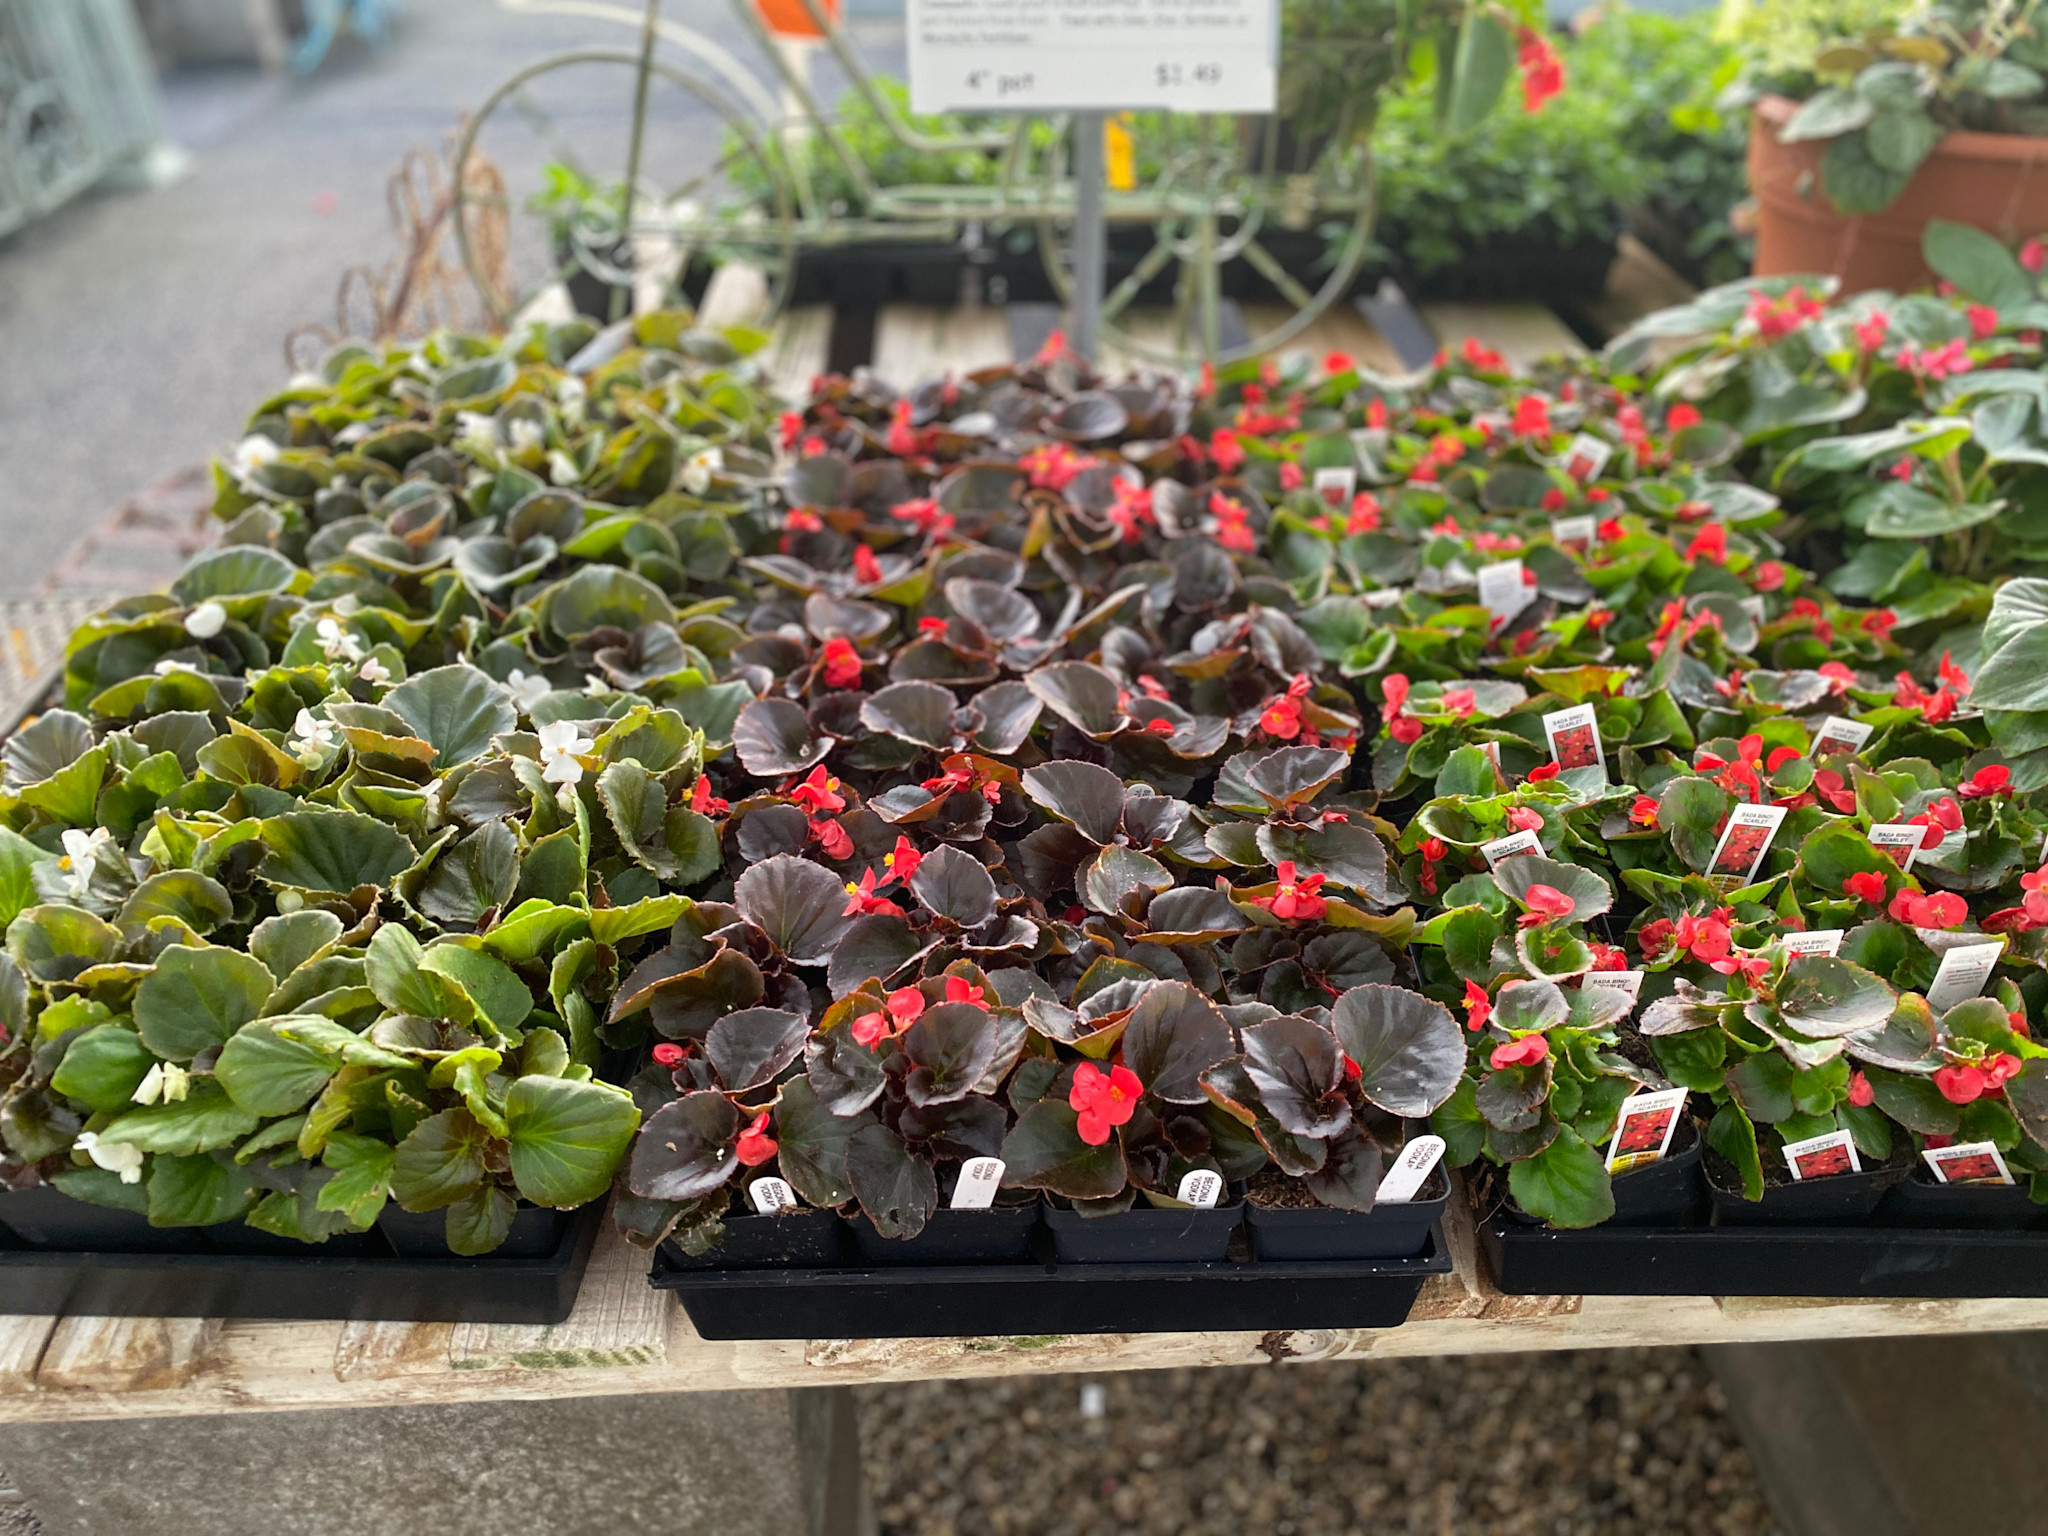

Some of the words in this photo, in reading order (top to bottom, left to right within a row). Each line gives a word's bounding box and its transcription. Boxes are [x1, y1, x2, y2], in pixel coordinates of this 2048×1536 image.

[1553, 717, 1568, 726] BADA
[1558, 719, 1582, 729] SCARLET
[1492, 845, 1508, 853] BADA
[1498, 843, 1524, 855] SCARLET
[1414, 1143, 1440, 1170] BEGONIA
[1197, 1176, 1215, 1203] BEGONIA
